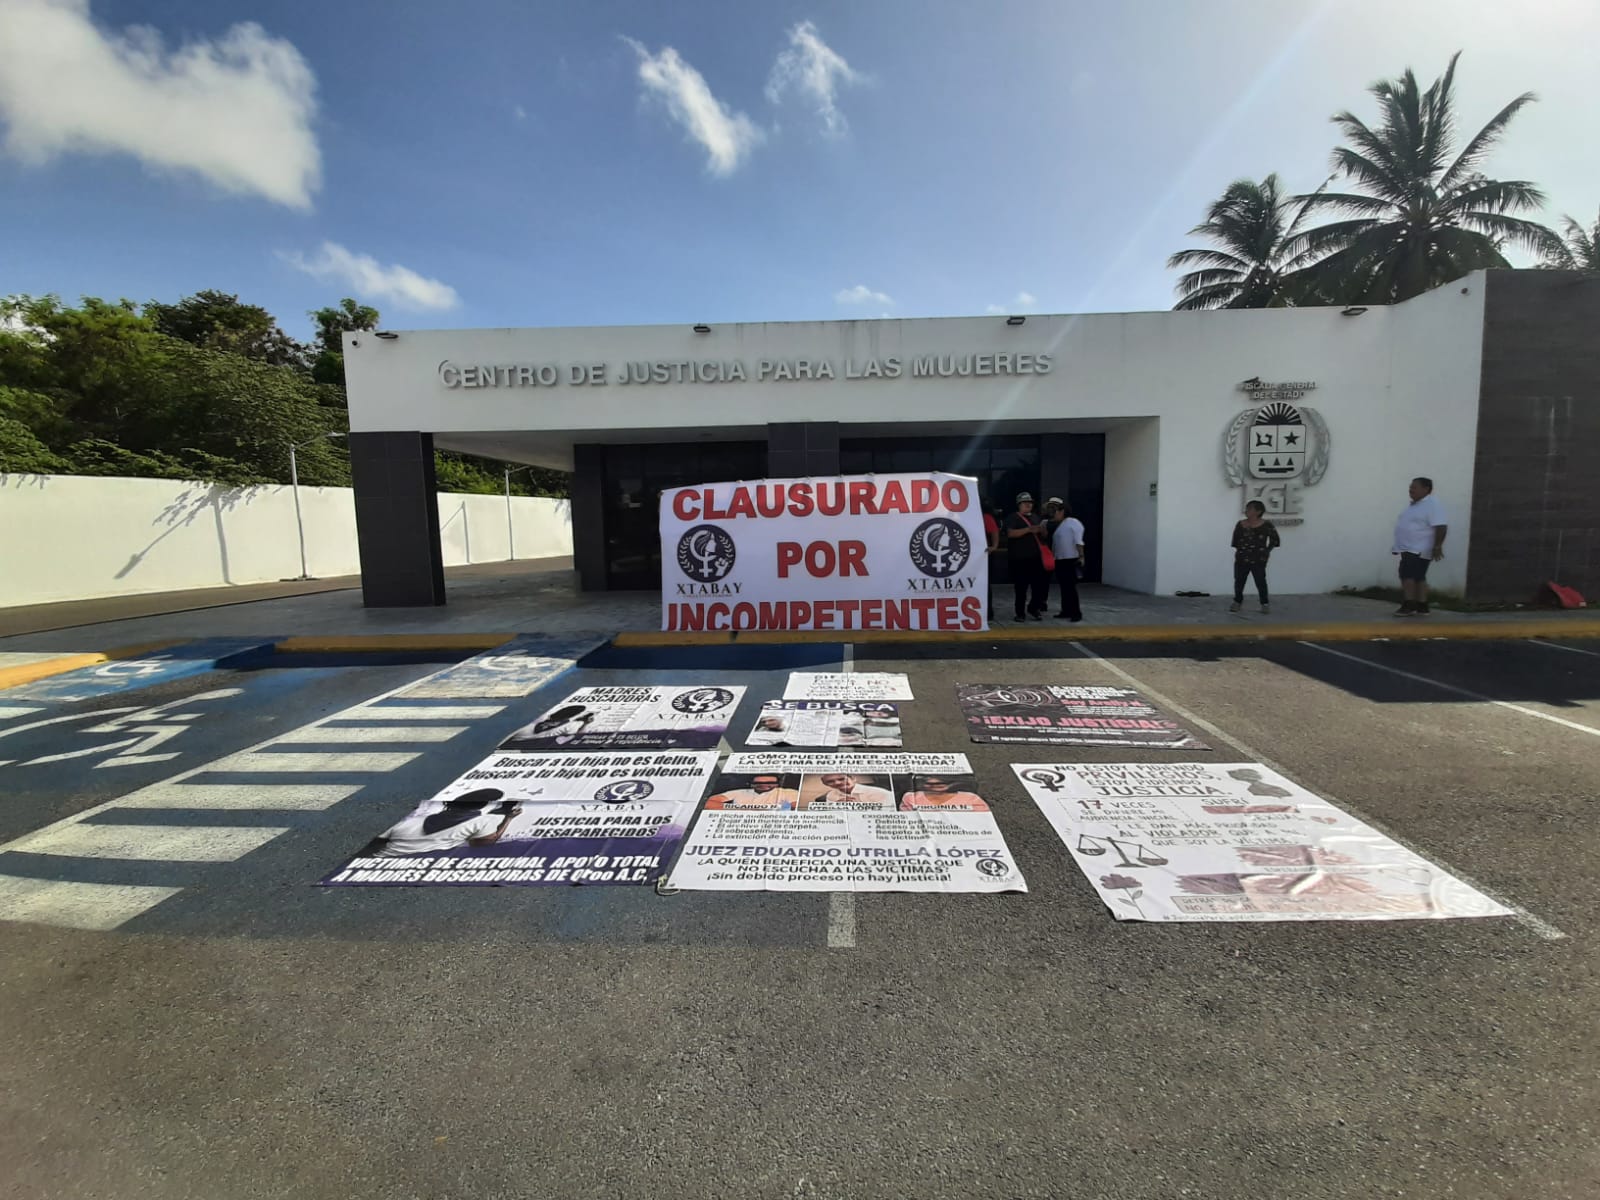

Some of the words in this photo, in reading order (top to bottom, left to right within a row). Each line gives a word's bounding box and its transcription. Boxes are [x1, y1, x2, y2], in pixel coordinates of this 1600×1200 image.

[440, 364, 558, 388] CENTRO
[568, 363, 607, 386] DE
[618, 361, 746, 385] JUSTICIA
[758, 359, 834, 380] PARA
[846, 357, 902, 379] LAS
[913, 352, 1052, 377] MUJERES
[673, 480, 969, 521] CLAUSURADO
[777, 540, 869, 578] POR
[676, 582, 743, 594] XTABAY
[907, 577, 976, 591] XTABAY
[668, 596, 982, 631] INCOMPETENTES
[766, 700, 796, 710] SE
[806, 701, 895, 710] BUSCA
[1057, 717, 1163, 729] JUSTICIA!
[494, 757, 549, 767] Buscar
[550, 759, 561, 767] a
[562, 757, 580, 767] tu
[580, 756, 609, 767] hija
[611, 758, 631, 766] no
[632, 757, 652, 766] es
[653, 755, 699, 766] delito,
[741, 752, 786, 760] ¿CÓMO
[522, 771, 535, 779] a
[535, 769, 553, 778] tu
[554, 768, 586, 779] hijo
[587, 769, 609, 778] no
[610, 768, 630, 777] es
[631, 766, 704, 777] violencia.
[1092, 786, 1232, 796] JUSTICIA.
[1077, 800, 1103, 810] 17
[1200, 797, 1249, 805] SUFRÍ
[533, 817, 600, 825] JUSTICIA
[603, 816, 642, 825] PARA
[644, 815, 673, 825] LOS
[531, 828, 658, 837] DESAPARECIDOS
[685, 846, 738, 856] JUEZ
[741, 846, 841, 857] EDUARDO
[847, 847, 931, 857] UTRILLA
[936, 846, 1004, 858] LÓPEZ
[430, 857, 459, 869] DE
[456, 857, 547, 869] CHETUMAL
[611, 856, 660, 868] TOTAL
[698, 858, 714, 866] ¿A
[717, 857, 759, 865] QUIÉN
[934, 859, 964, 867] QUE
[875, 864, 949, 873] VÍCTIMAS?
[330, 869, 353, 881] A
[345, 869, 426, 882] MADRES
[422, 869, 544, 881] BUSCADORAS
[544, 869, 571, 881] DE
[707, 872, 733, 880] ¡Sin
[737, 871, 785, 880] debido
[788, 873, 843, 882] proceso
[868, 873, 892, 883] hay
[897, 873, 952, 883] justicia!
